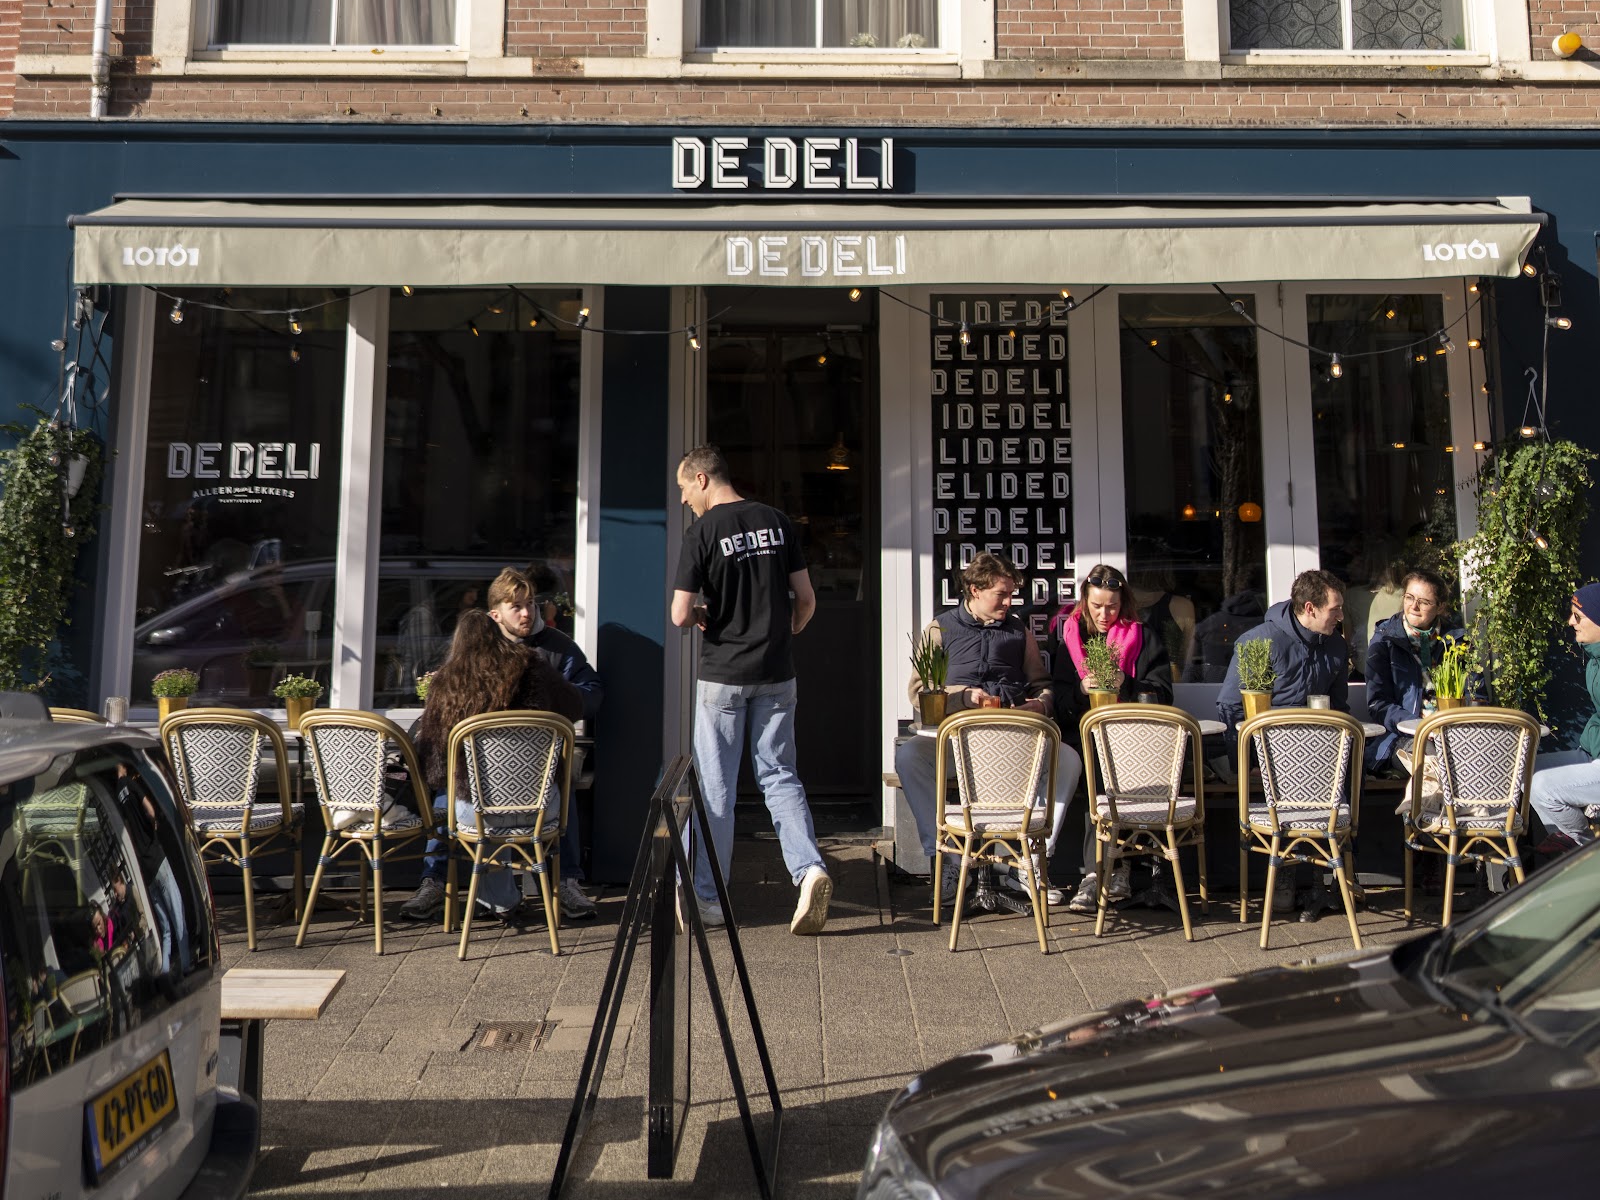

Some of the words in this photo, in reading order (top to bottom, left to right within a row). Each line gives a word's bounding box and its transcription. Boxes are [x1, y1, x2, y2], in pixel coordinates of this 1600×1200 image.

[672, 137, 749, 189] DE
[764, 137, 894, 190] DELI
[122, 243, 200, 267] LOT61
[726, 236, 789, 276] DE
[801, 235, 906, 277] DELI
[1422, 238, 1500, 261] LOT61
[934, 334, 1066, 361] ELIDED
[931, 368, 1063, 395] DEDELI
[166, 442, 223, 479] DE
[229, 442, 321, 480] DELI
[939, 437, 1072, 465] LIDEDE
[192, 486, 233, 499] ALLEEN
[247, 486, 295, 499] LEKKERS
[936, 472, 1070, 499] ELIDED
[933, 507, 1067, 535] DEDELI
[719, 532, 746, 557] DE
[744, 527, 785, 550] DELI
